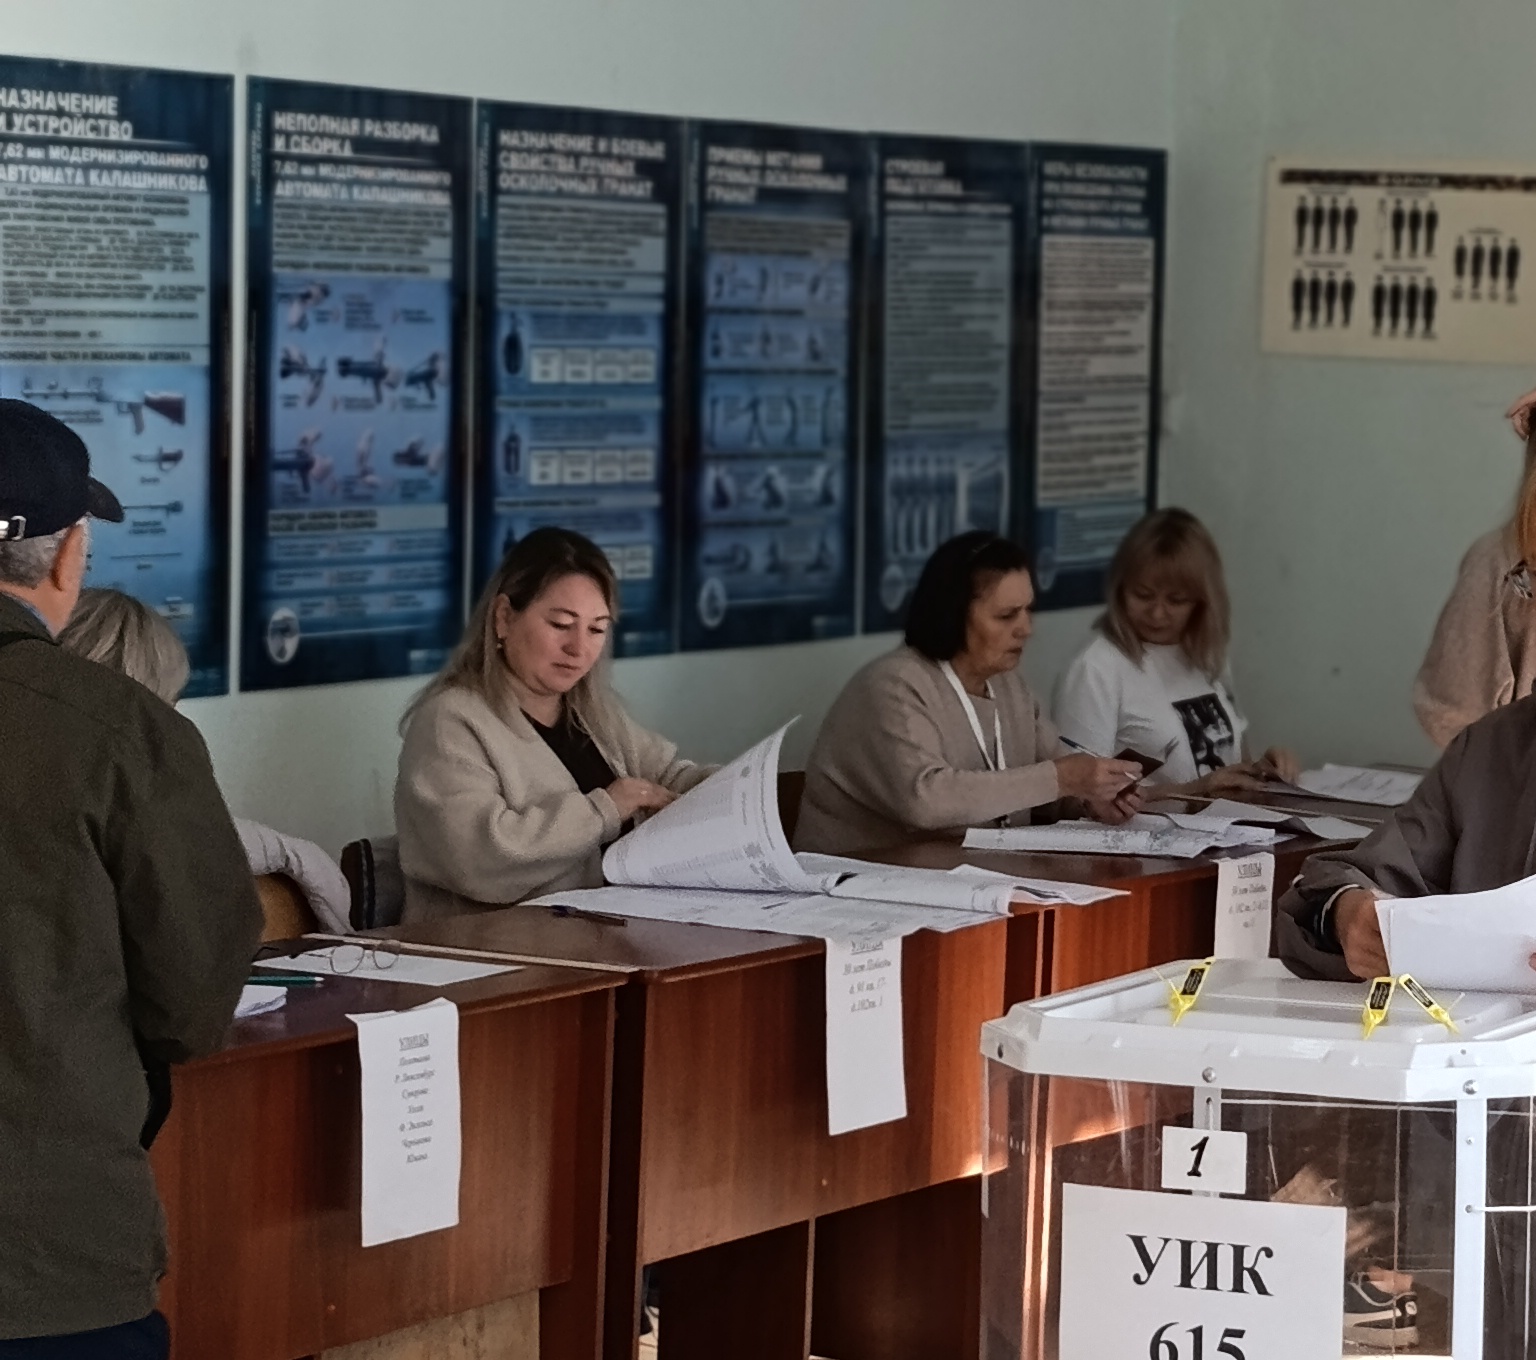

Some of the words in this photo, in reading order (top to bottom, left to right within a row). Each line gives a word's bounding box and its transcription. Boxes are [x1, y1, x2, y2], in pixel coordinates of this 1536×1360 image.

[14, 113, 134, 139] УСТРОЙСТВО
[274, 111, 360, 136] НЕПОЛНАЯ
[364, 118, 440, 143] РАЗБОРКА
[289, 134, 354, 155] СБОРКА
[90, 168, 208, 192] КАЛАШНИКОВА
[1186, 1135, 1210, 1178] 1
[1126, 1233, 1275, 1297] УИК
